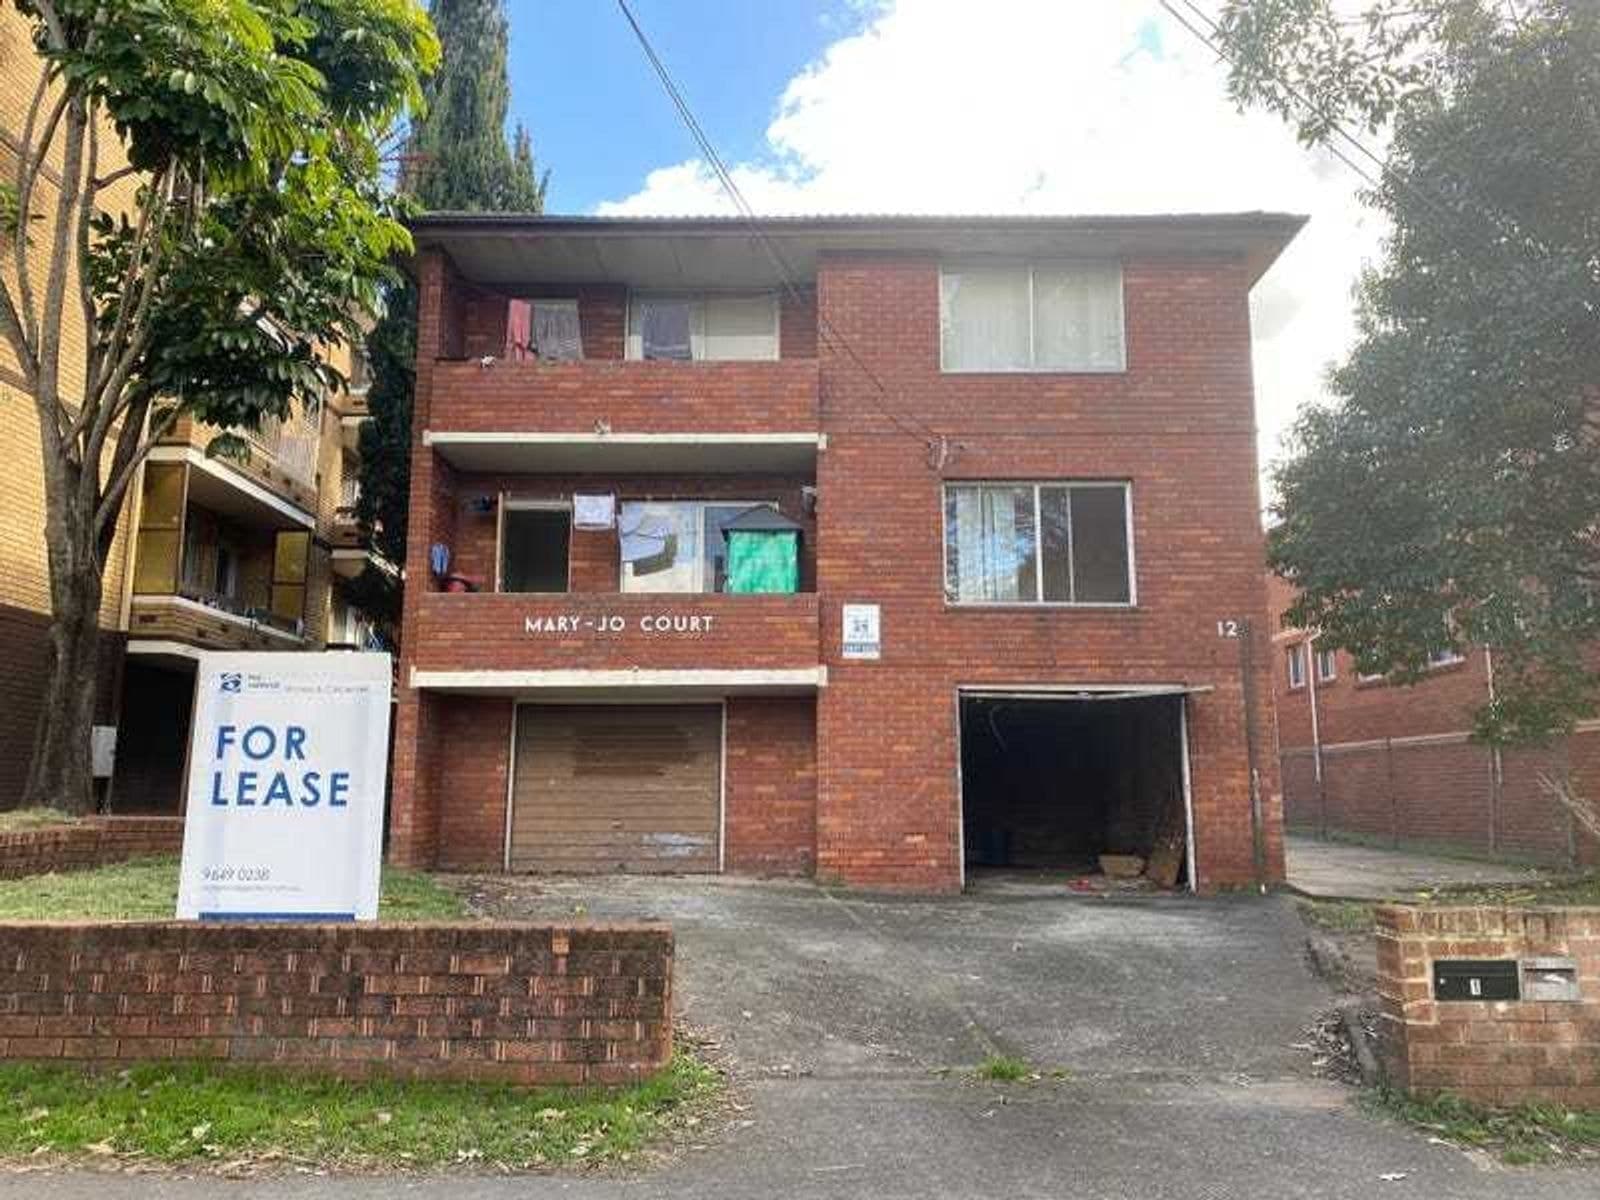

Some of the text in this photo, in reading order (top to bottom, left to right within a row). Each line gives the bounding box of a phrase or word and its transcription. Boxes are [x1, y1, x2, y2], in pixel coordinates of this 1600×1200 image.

[525, 615, 713, 633] MARY-JO COURT
[1217, 620, 1238, 637] 12
[215, 725, 307, 761] FOR
[211, 771, 350, 808] LEASE
